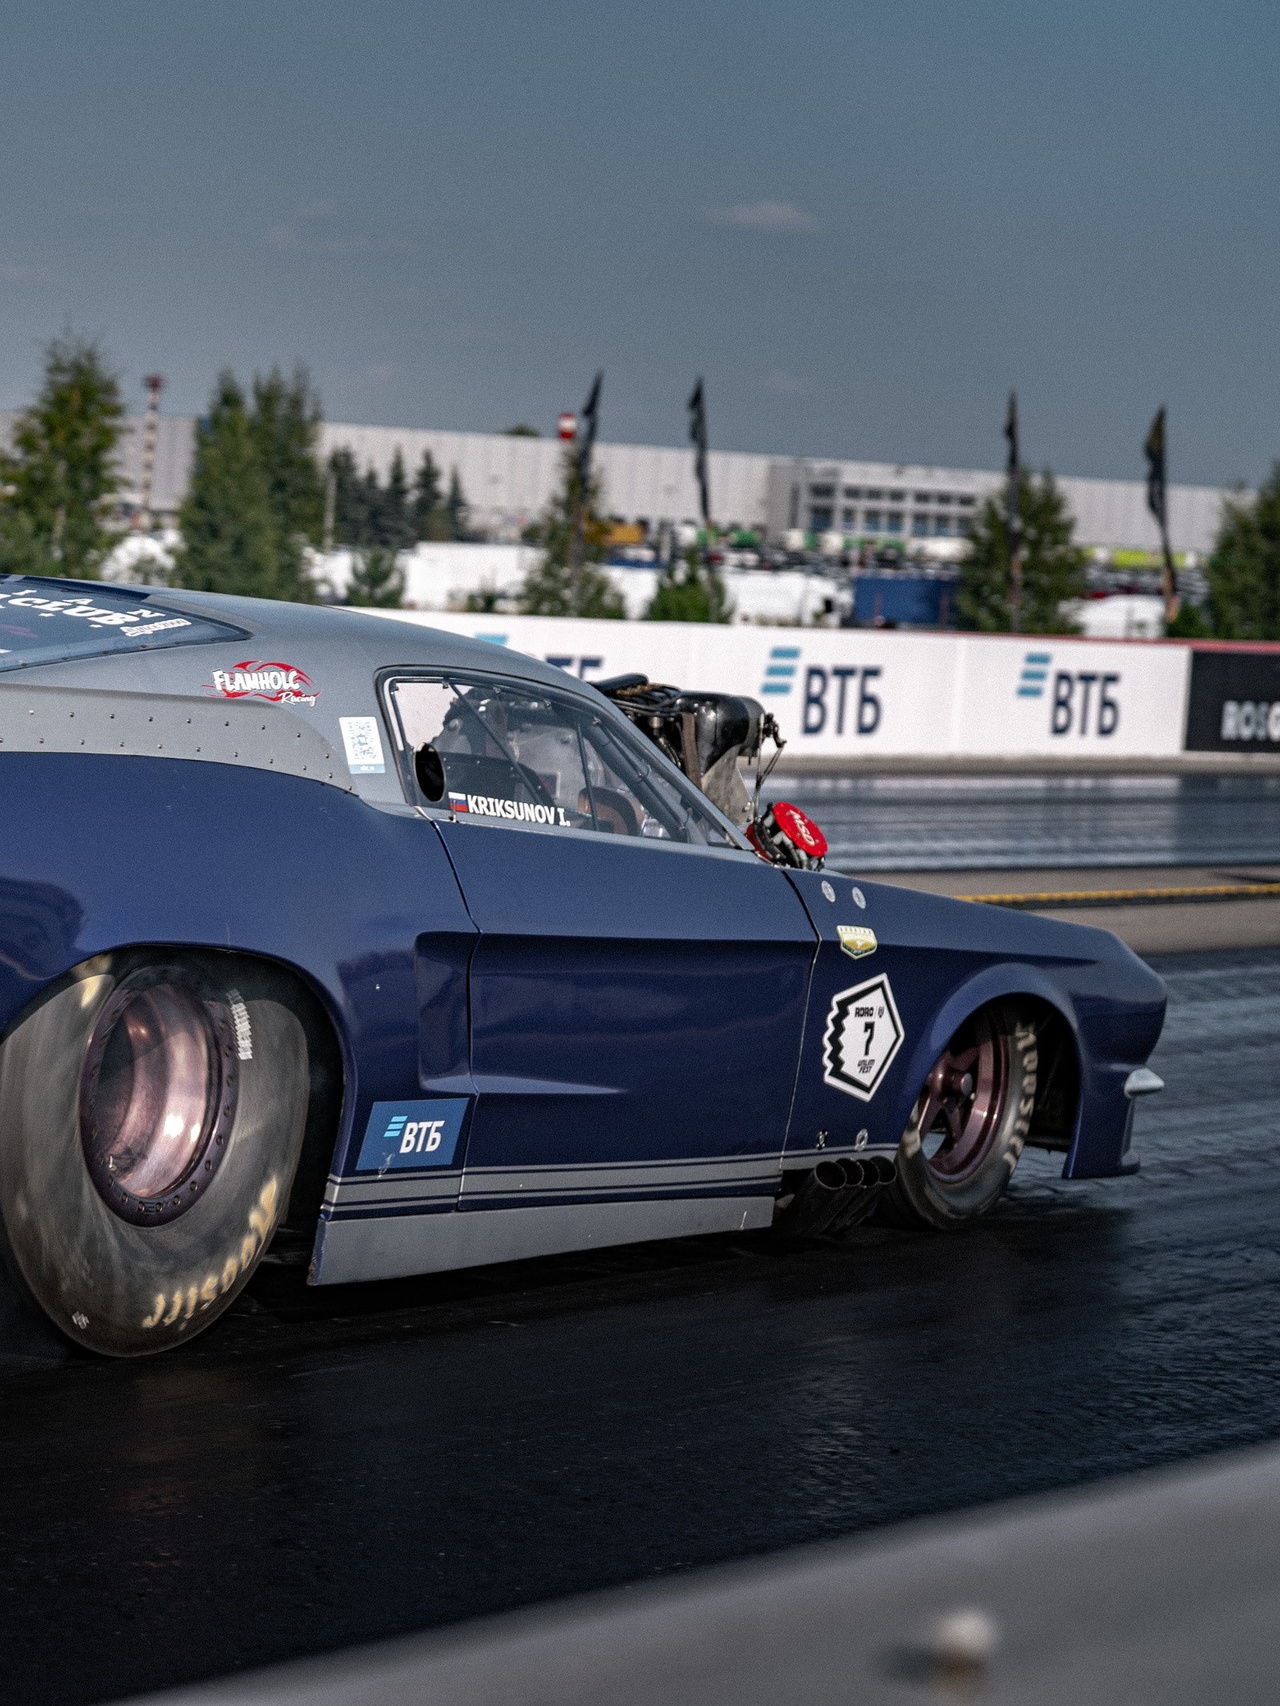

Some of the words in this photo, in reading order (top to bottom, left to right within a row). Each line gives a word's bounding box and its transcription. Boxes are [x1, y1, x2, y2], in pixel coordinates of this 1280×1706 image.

[7, 597, 140, 625] CLUB
[212, 670, 301, 692] FLAMHOLC
[278, 690, 317, 707] Racing
[802, 665, 882, 735] ВТБ
[1051, 671, 1120, 736] ВТБ
[466, 794, 556, 825] KRIKSUNOV
[863, 1021, 876, 1056] 7
[399, 1120, 446, 1154] ВТБ
